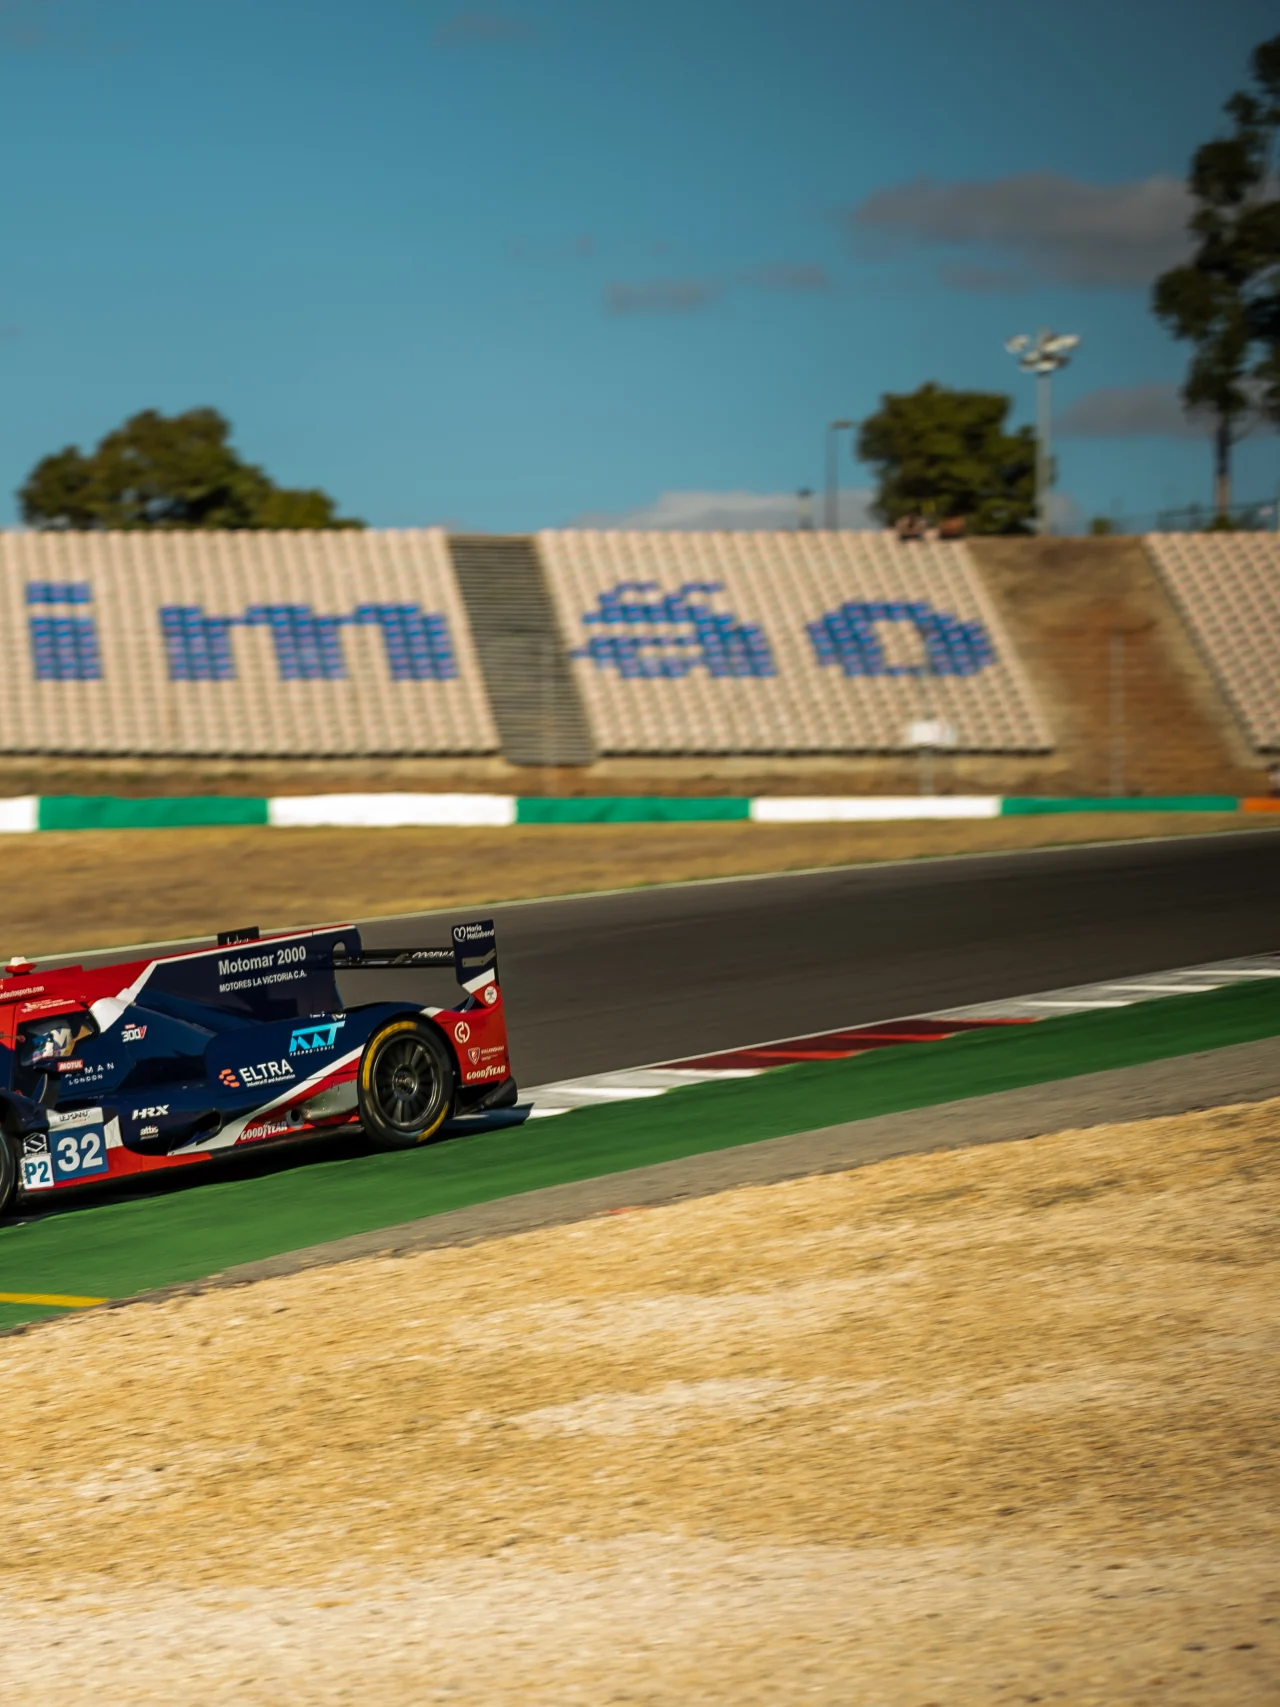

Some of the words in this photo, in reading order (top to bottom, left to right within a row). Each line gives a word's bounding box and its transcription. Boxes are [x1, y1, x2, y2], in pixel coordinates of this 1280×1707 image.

[218, 954, 275, 975] Motomar
[277, 945, 307, 965] 2000
[219, 980, 252, 993] MOTORES
[253, 977, 262, 987] LA
[262, 972, 294, 985] VICTORIA
[294, 969, 307, 980] C.A.
[121, 1025, 147, 1043] 300V
[59, 1060, 83, 1071] MOTUL
[239, 1058, 294, 1083] ELTRA
[466, 1065, 506, 1080] GOODYEAR
[68, 1074, 103, 1086] LONDON
[131, 1104, 170, 1121] HRX
[140, 1125, 159, 1136] attis
[240, 1121, 288, 1141] GOODYEAR
[57, 1132, 103, 1172] 32
[24, 1160, 51, 1185] P2
